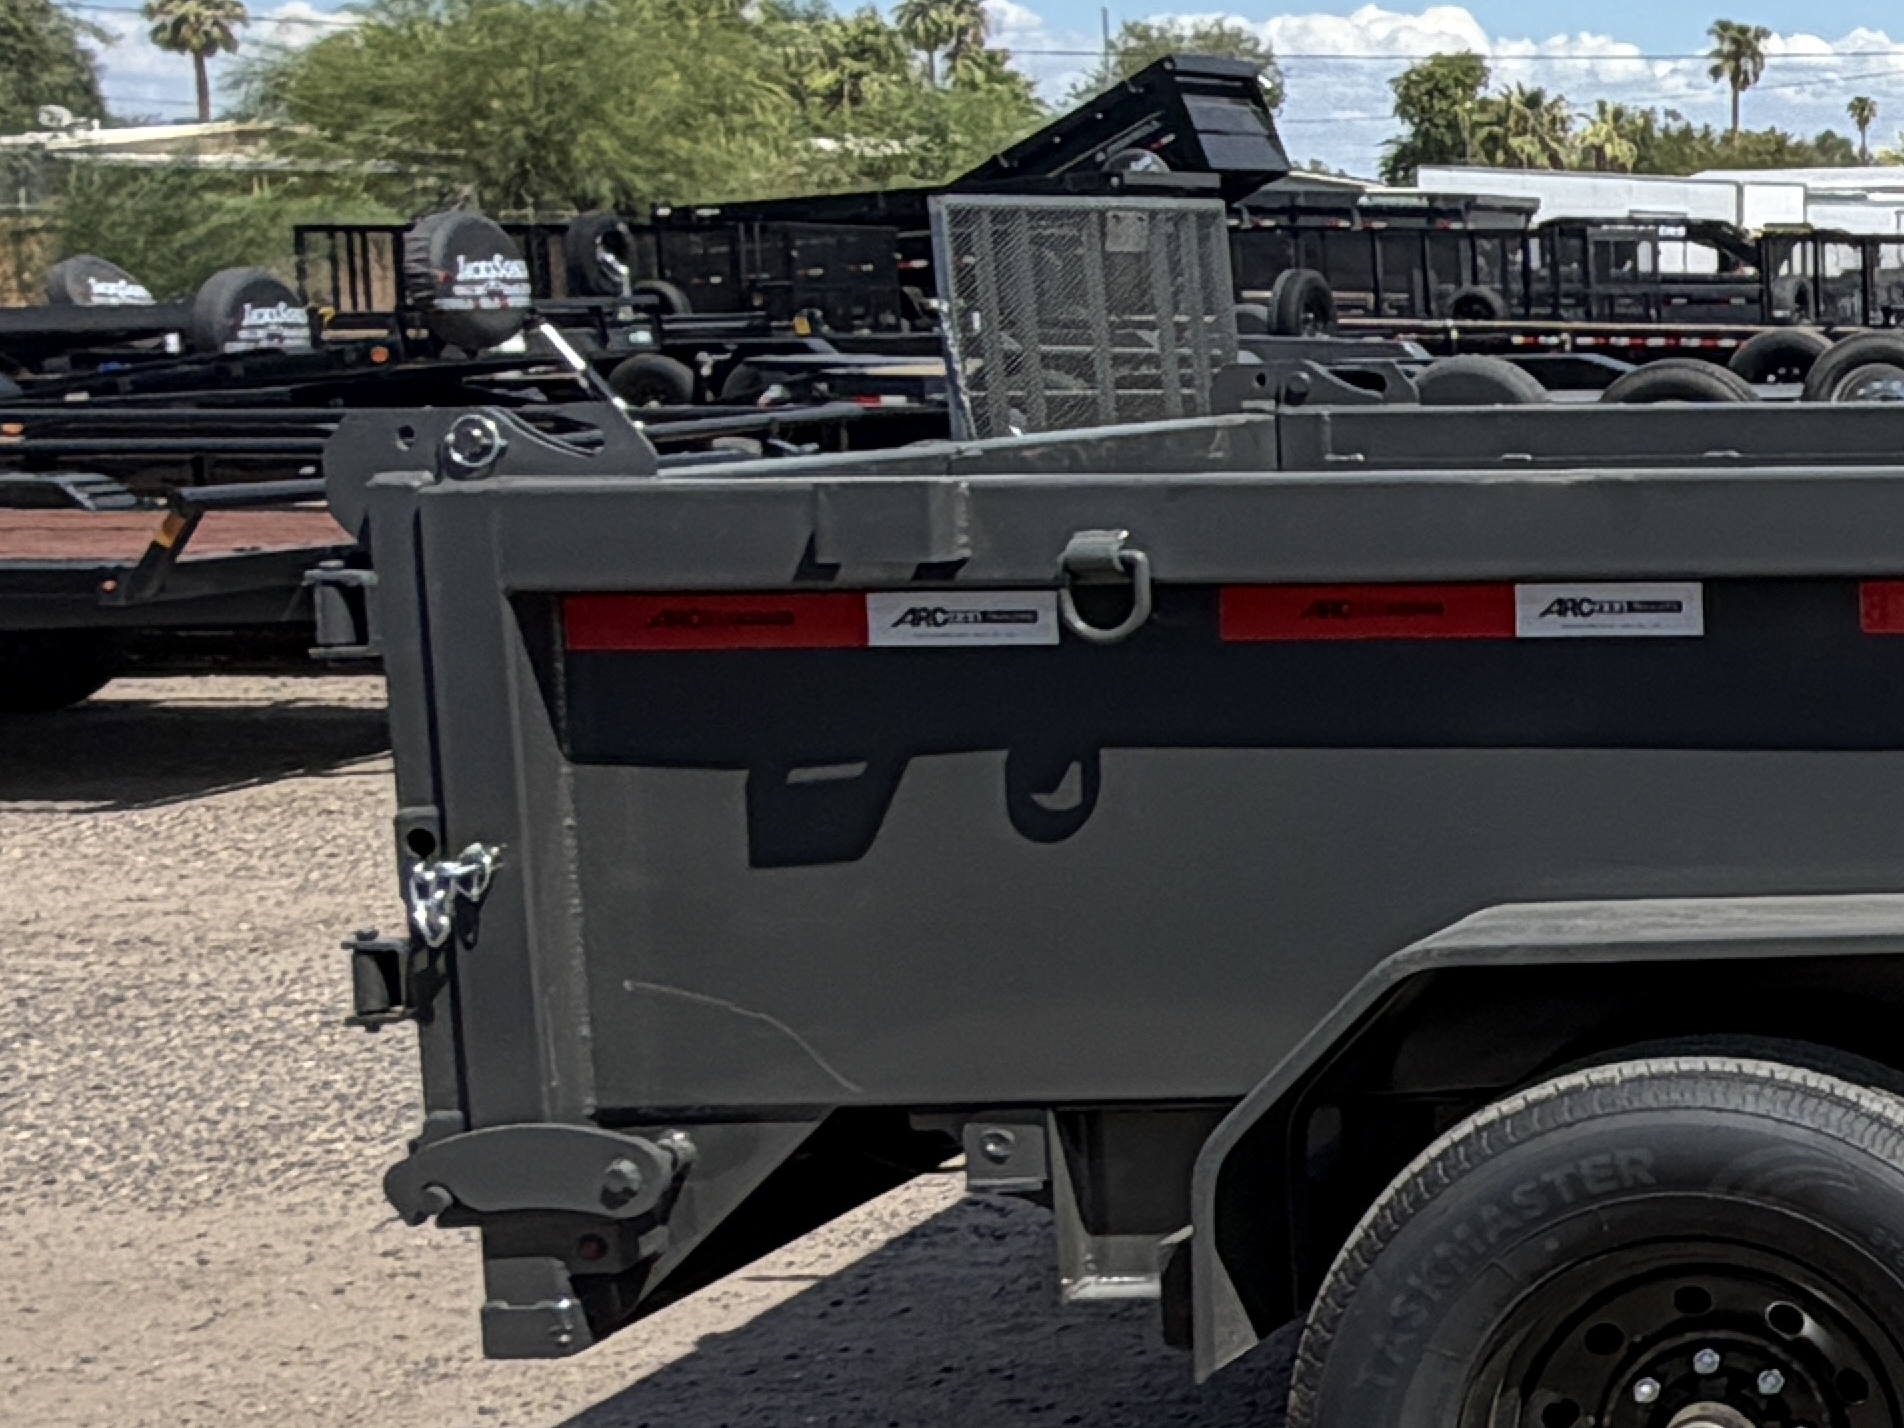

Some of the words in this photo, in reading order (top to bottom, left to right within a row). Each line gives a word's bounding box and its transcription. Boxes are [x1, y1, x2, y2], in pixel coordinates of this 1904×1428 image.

[890, 606, 950, 628] ARC
[1538, 596, 1595, 618] ARC
[1351, 1146, 1658, 1392] TASKMASTER
